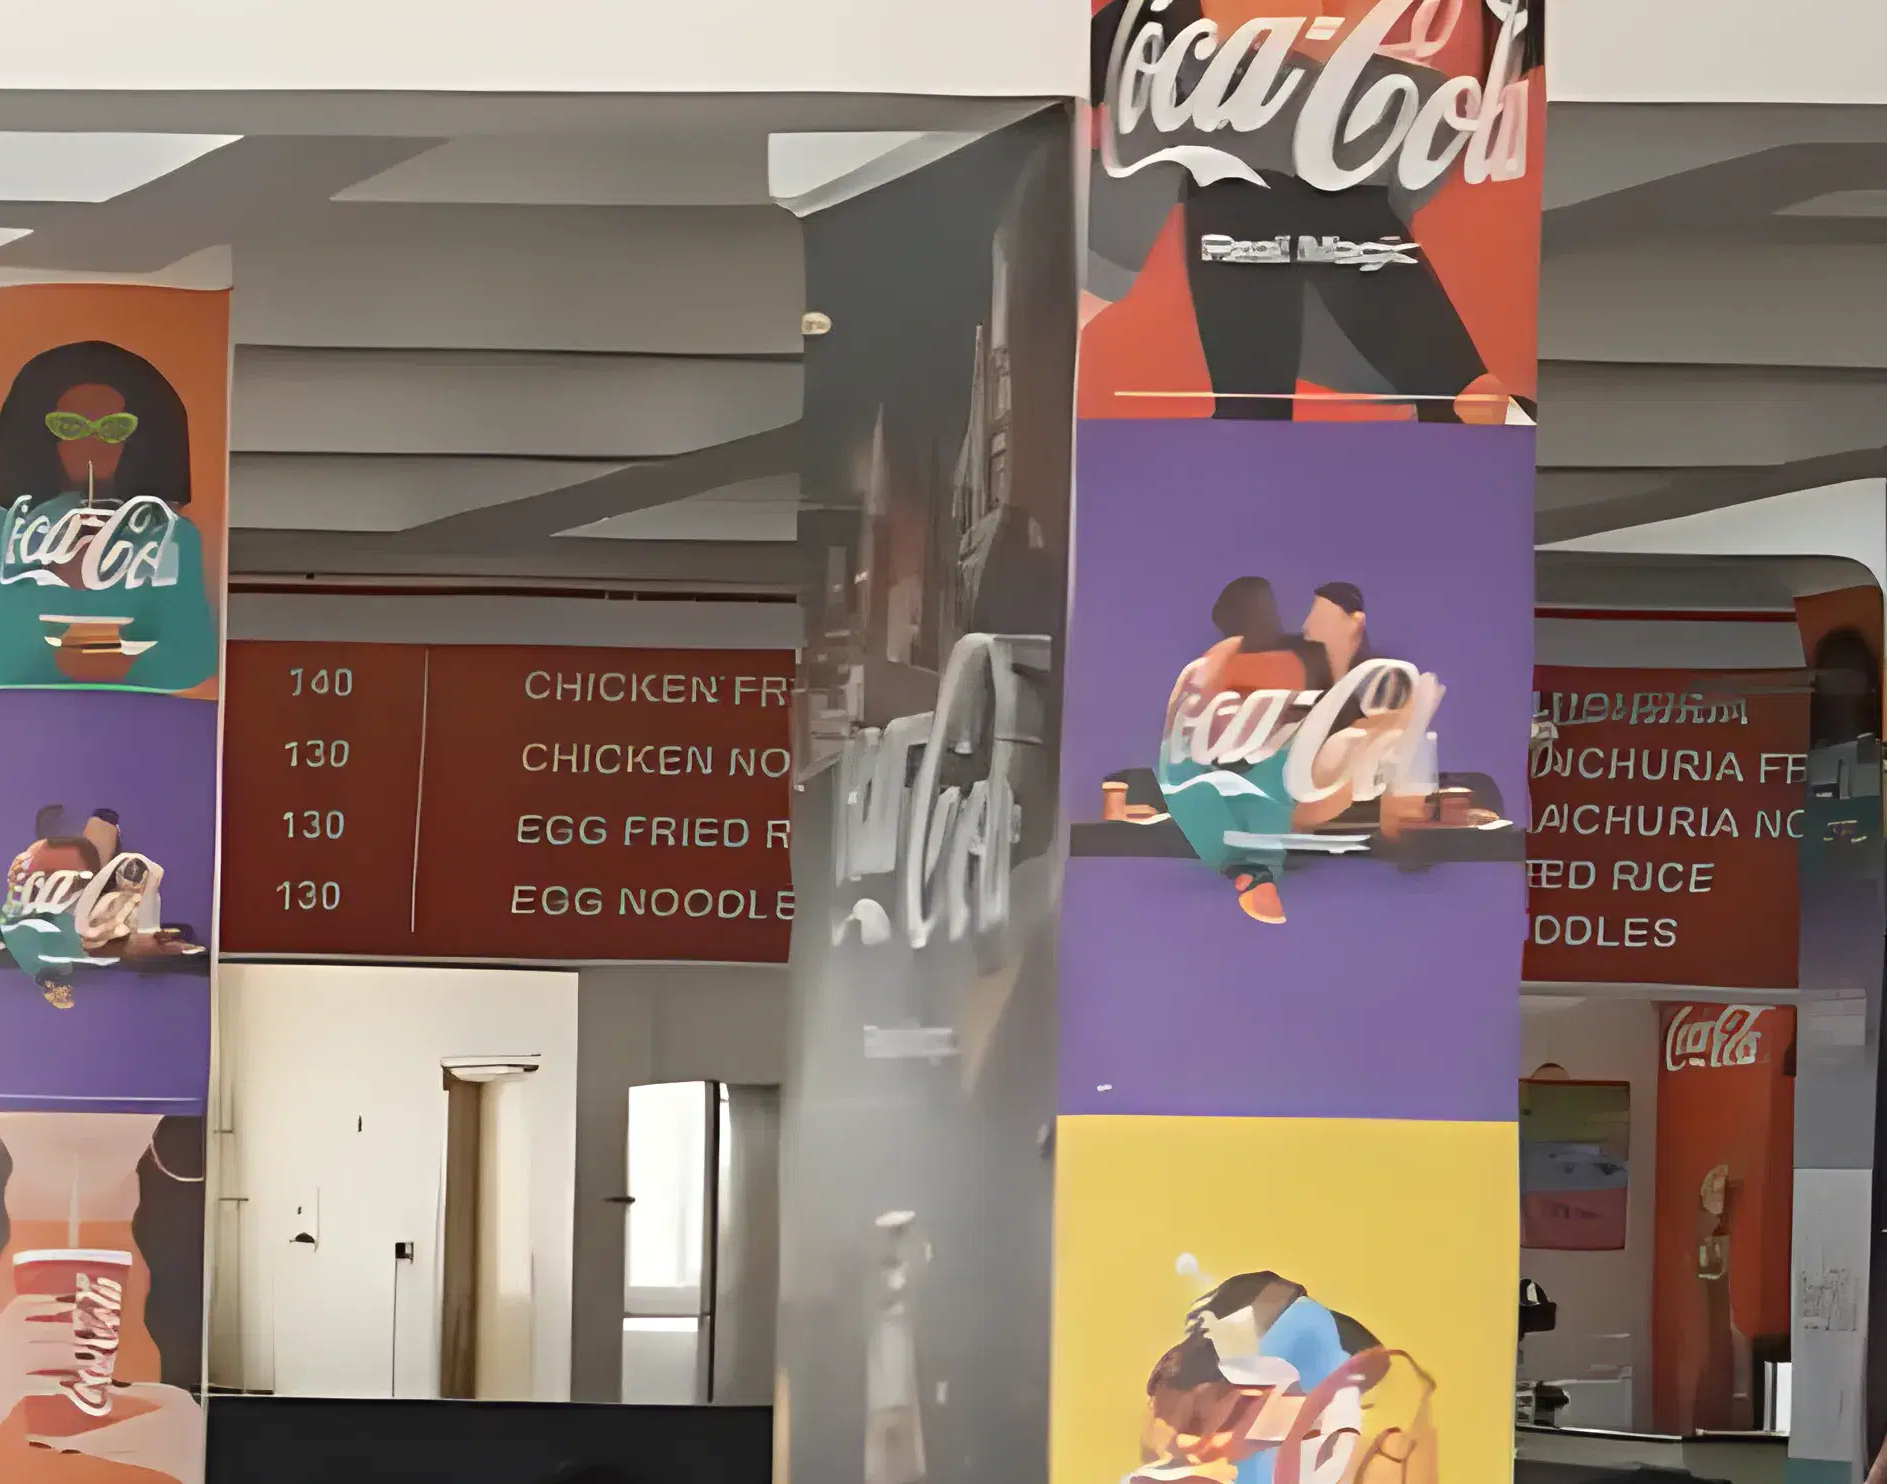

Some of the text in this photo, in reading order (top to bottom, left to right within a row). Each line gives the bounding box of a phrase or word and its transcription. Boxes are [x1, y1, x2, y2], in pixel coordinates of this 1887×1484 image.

[524, 670, 717, 704] CHICKEN
[283, 739, 351, 769] 130
[521, 742, 791, 779] CHICKEN NO
[282, 810, 345, 840] 130
[516, 814, 791, 849] EGG FRIED R
[1611, 860, 1715, 894] RICE
[275, 880, 341, 910] 130
[510, 885, 797, 920] EGG NOODLE
